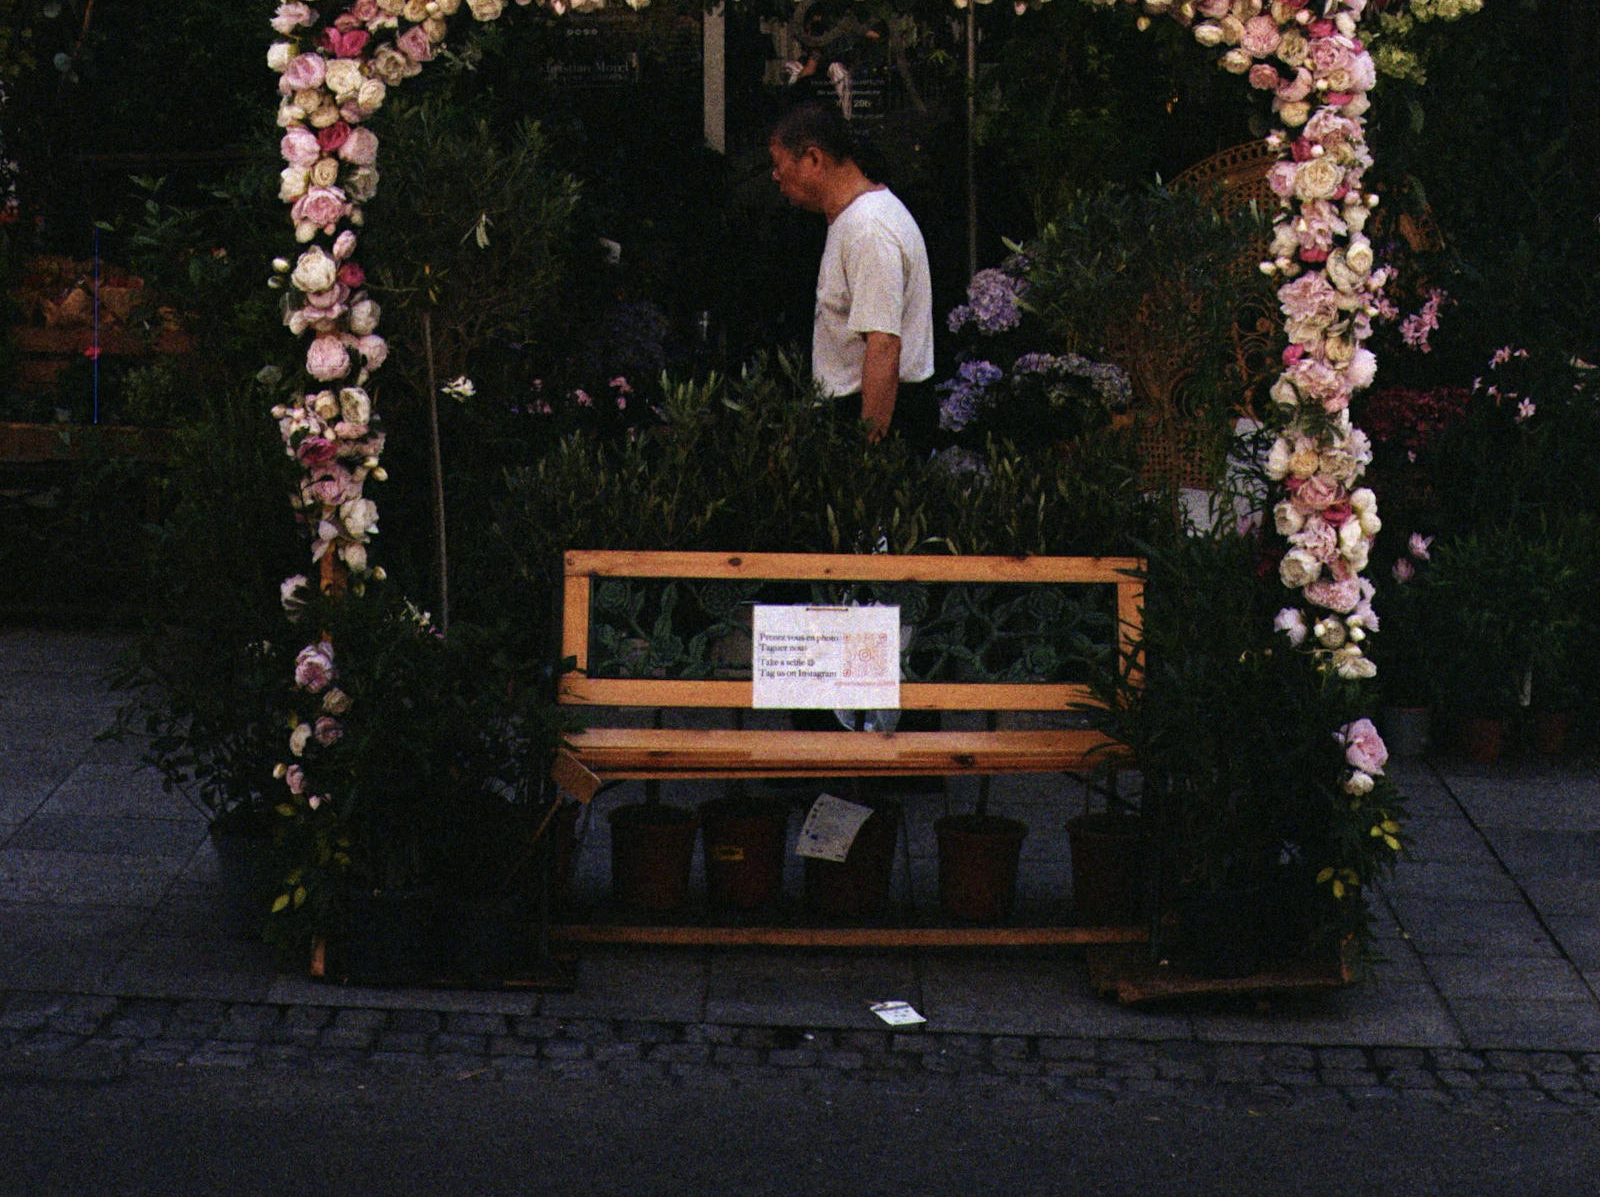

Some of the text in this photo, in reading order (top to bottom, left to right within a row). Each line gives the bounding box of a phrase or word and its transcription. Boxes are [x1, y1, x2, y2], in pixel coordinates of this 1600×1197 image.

[759, 633, 785, 641] Prenez
[816, 633, 839, 643] photo
[759, 643, 788, 653] Taguer
[759, 658, 779, 666] Take
[786, 658, 806, 666] selfie
[759, 669, 775, 679] Tag
[798, 669, 837, 679] Instagram
